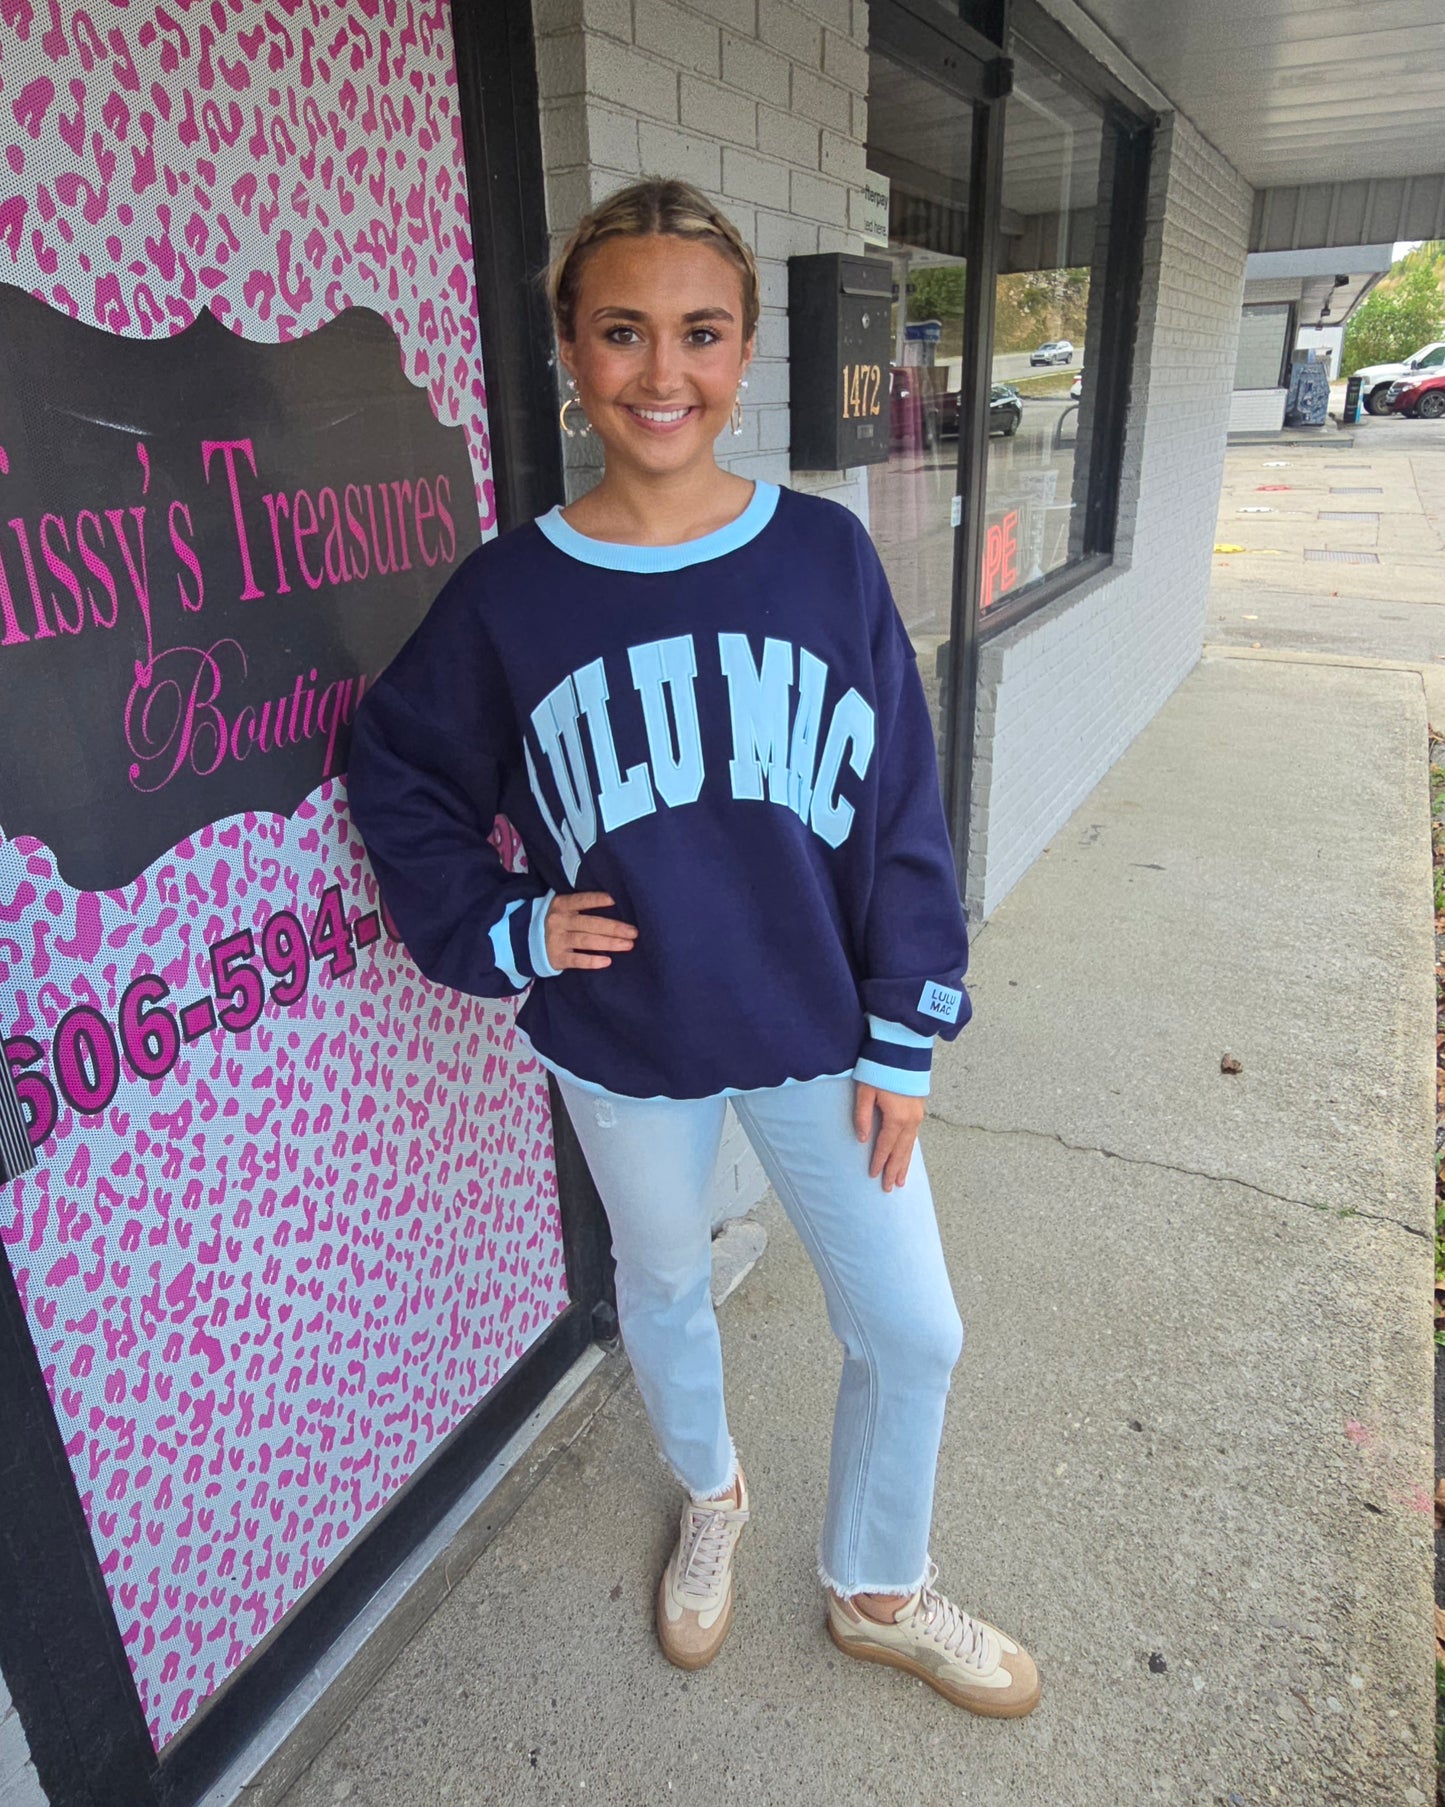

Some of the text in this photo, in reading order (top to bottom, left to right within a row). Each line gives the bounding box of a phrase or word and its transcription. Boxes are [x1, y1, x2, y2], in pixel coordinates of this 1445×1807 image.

[864, 184, 888, 210] fterpay
[842, 364, 880, 418] 1472
[202, 438, 457, 601] Treasures
[124, 638, 386, 793] Boutiqu
[717, 632, 875, 850] MAC
[1, 883, 403, 1149] 606-594-
[930, 1000, 952, 1016] MAC
[931, 988, 957, 1006] LULU
